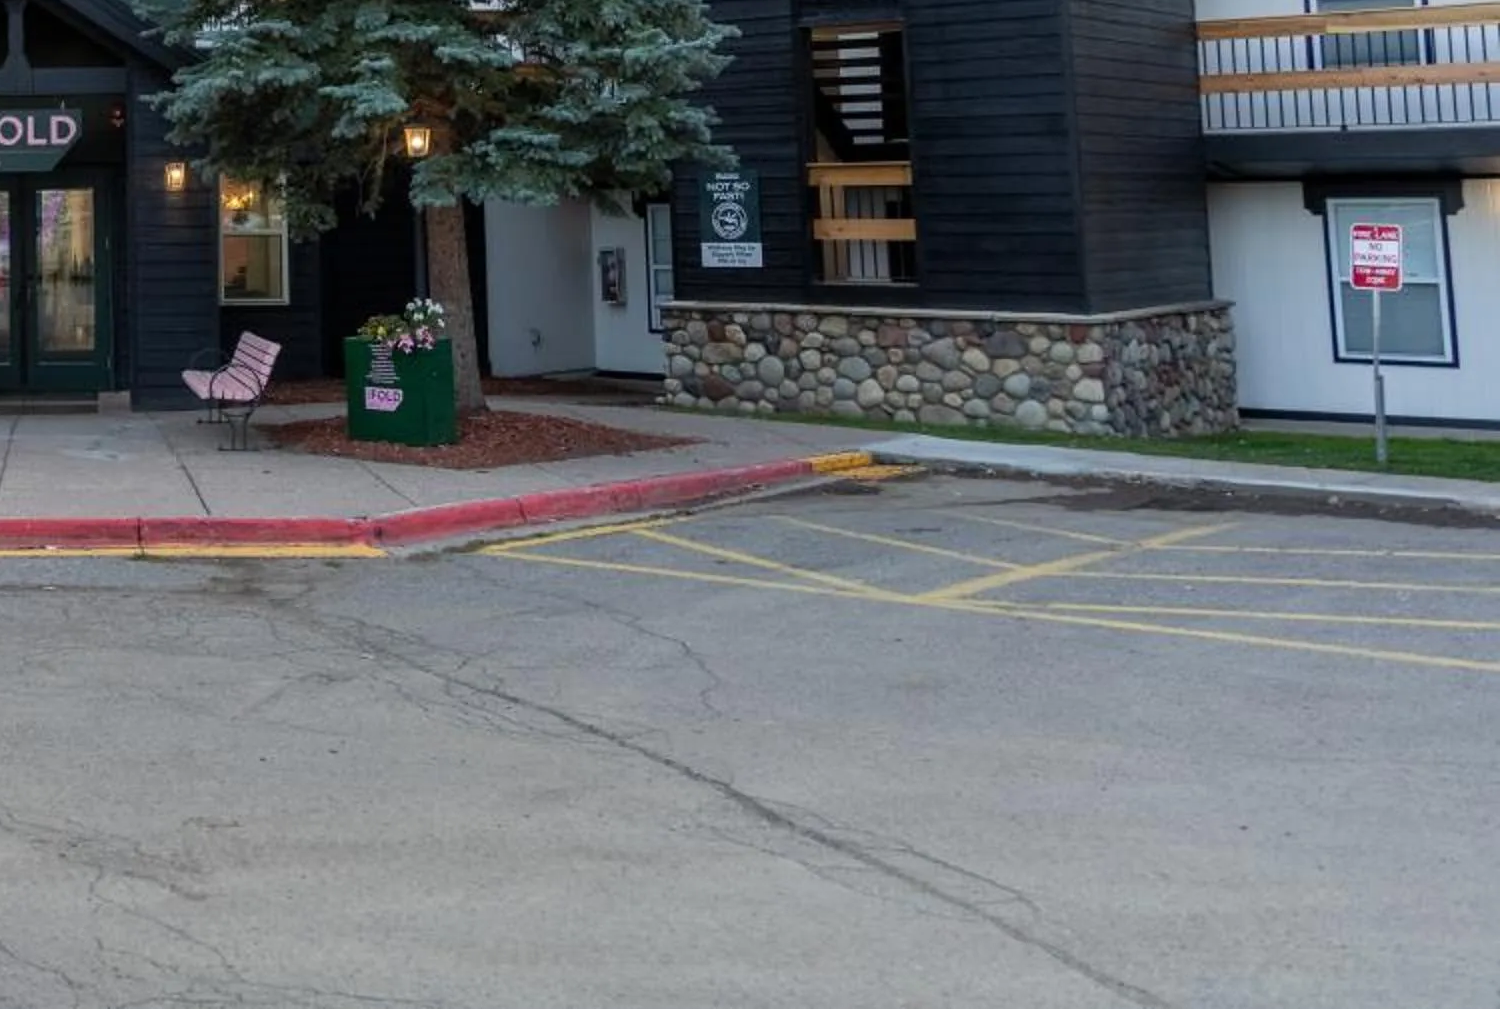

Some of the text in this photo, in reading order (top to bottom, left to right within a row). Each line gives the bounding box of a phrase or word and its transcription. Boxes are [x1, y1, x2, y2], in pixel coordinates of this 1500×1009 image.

[706, 182, 731, 191] NOT
[1369, 243, 1382, 251] NO
[1354, 254, 1397, 264] PARKING
